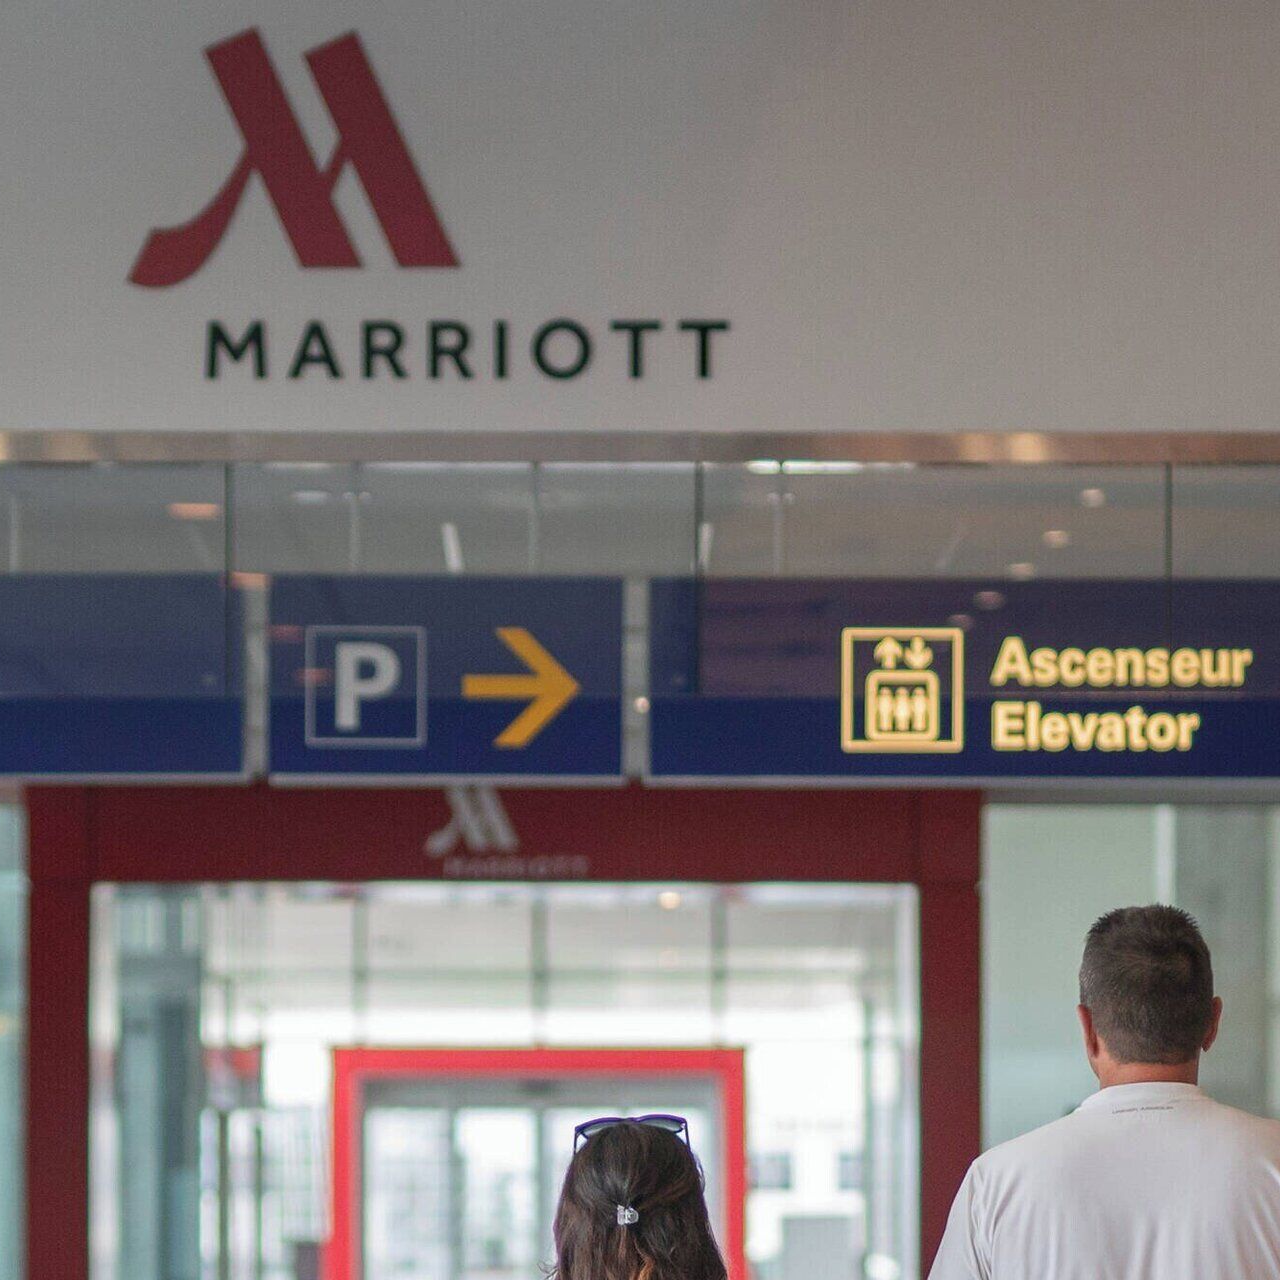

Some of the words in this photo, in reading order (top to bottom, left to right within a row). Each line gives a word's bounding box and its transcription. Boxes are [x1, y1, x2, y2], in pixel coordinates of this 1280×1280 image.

[204, 318, 732, 380] MARRIOTT
[335, 640, 402, 732] P
[989, 635, 1254, 686] Ascenseur
[991, 700, 1200, 752] Elevator
